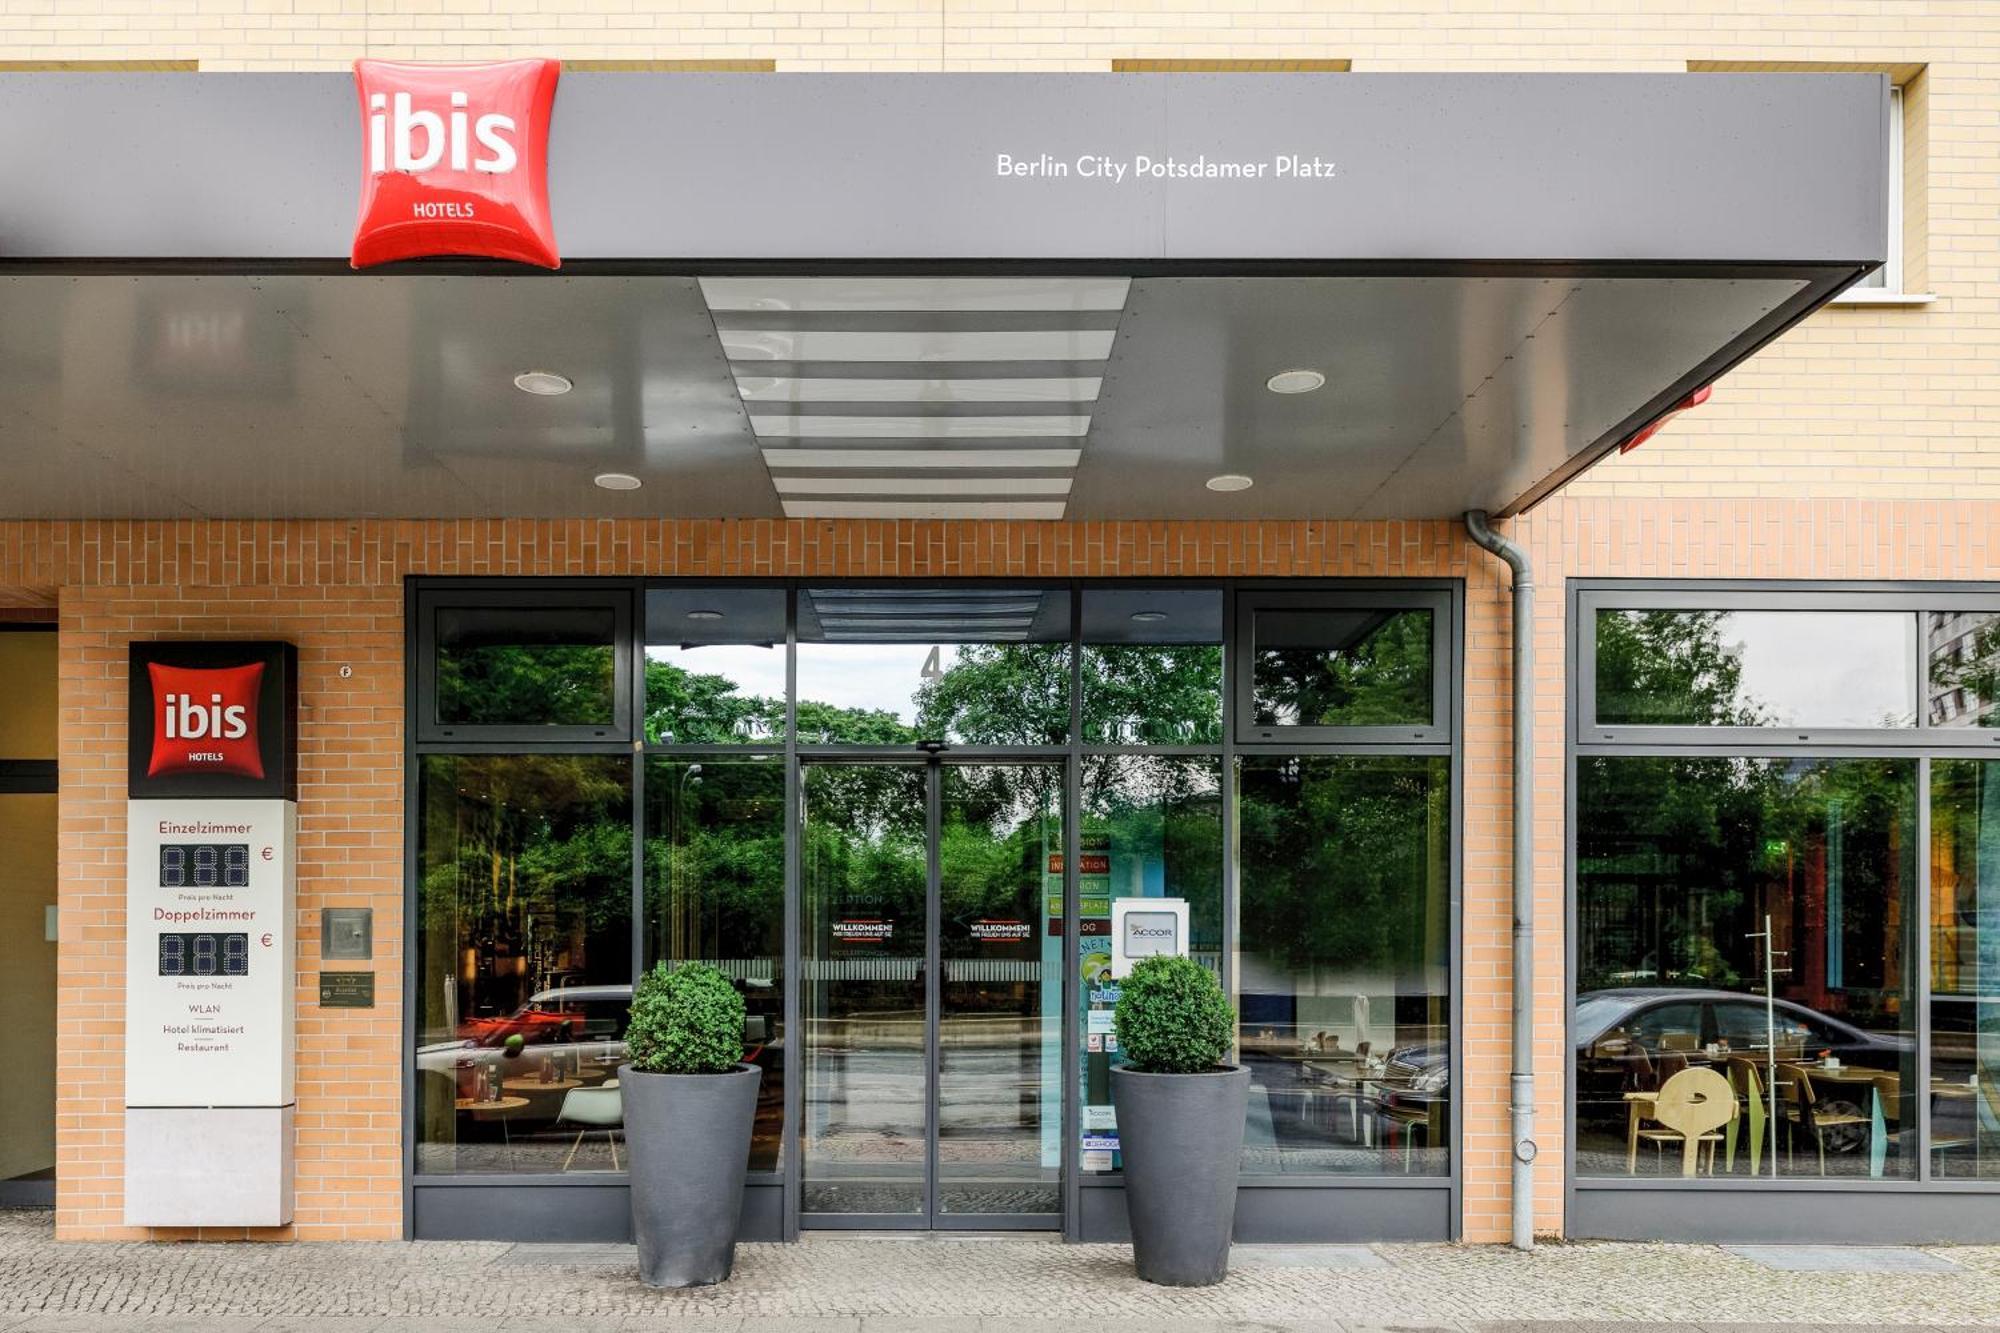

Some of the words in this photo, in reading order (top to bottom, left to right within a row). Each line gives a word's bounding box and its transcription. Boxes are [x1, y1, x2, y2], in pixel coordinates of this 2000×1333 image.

[371, 92, 517, 174] ibis
[998, 154, 1068, 177] Berlin
[1076, 154, 1128, 184] City
[1136, 154, 1268, 178] Potsdamer
[1276, 154, 1336, 178] Platz
[413, 202, 474, 217] HOTELS
[921, 646, 943, 684] 4
[165, 693, 247, 739] ibis
[189, 752, 223, 761] HOTELS
[159, 821, 252, 834] Einzelzimmer
[154, 907, 256, 923] Doppelzimmer
[832, 923, 893, 932] WILLKOMMEN!
[970, 924, 1030, 932] WILLKOMMEN!
[189, 1004, 220, 1014] WLAN
[163, 1024, 189, 1034] Hotel
[191, 1024, 244, 1034] klimatisiert
[177, 1043, 229, 1052] Restaurant
